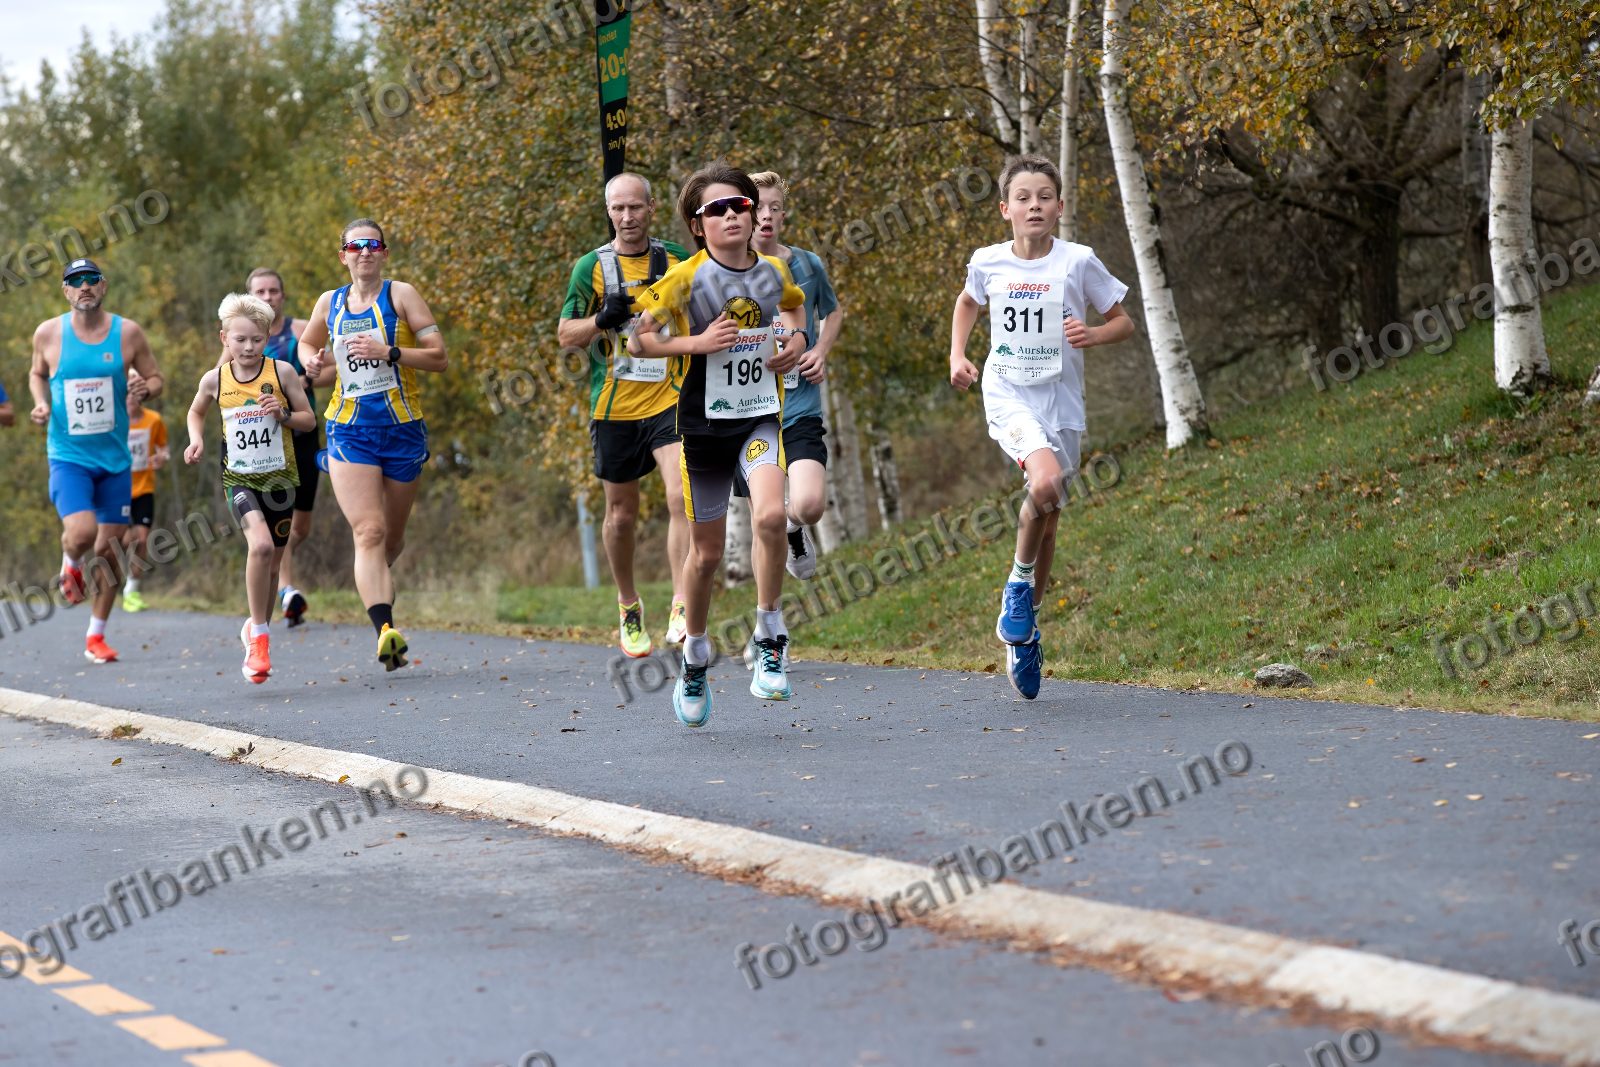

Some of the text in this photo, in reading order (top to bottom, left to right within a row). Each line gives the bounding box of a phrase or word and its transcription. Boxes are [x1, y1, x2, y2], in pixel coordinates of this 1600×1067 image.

[606, 108, 628, 130] 4:0
[1006, 282, 1050, 292] NORGES
[1009, 291, 1042, 300] LØPET
[1003, 306, 1043, 334] 311
[735, 333, 768, 344] ORGES
[729, 342, 762, 353] LØPET
[1017, 345, 1060, 357] Aurskog
[722, 357, 763, 386] 196
[364, 375, 394, 387] Aurskog
[75, 396, 105, 414] 912
[737, 394, 776, 408] Aurskog
[238, 416, 264, 425] LØPET
[235, 427, 271, 450] 344
[251, 455, 283, 466] Aurskog
